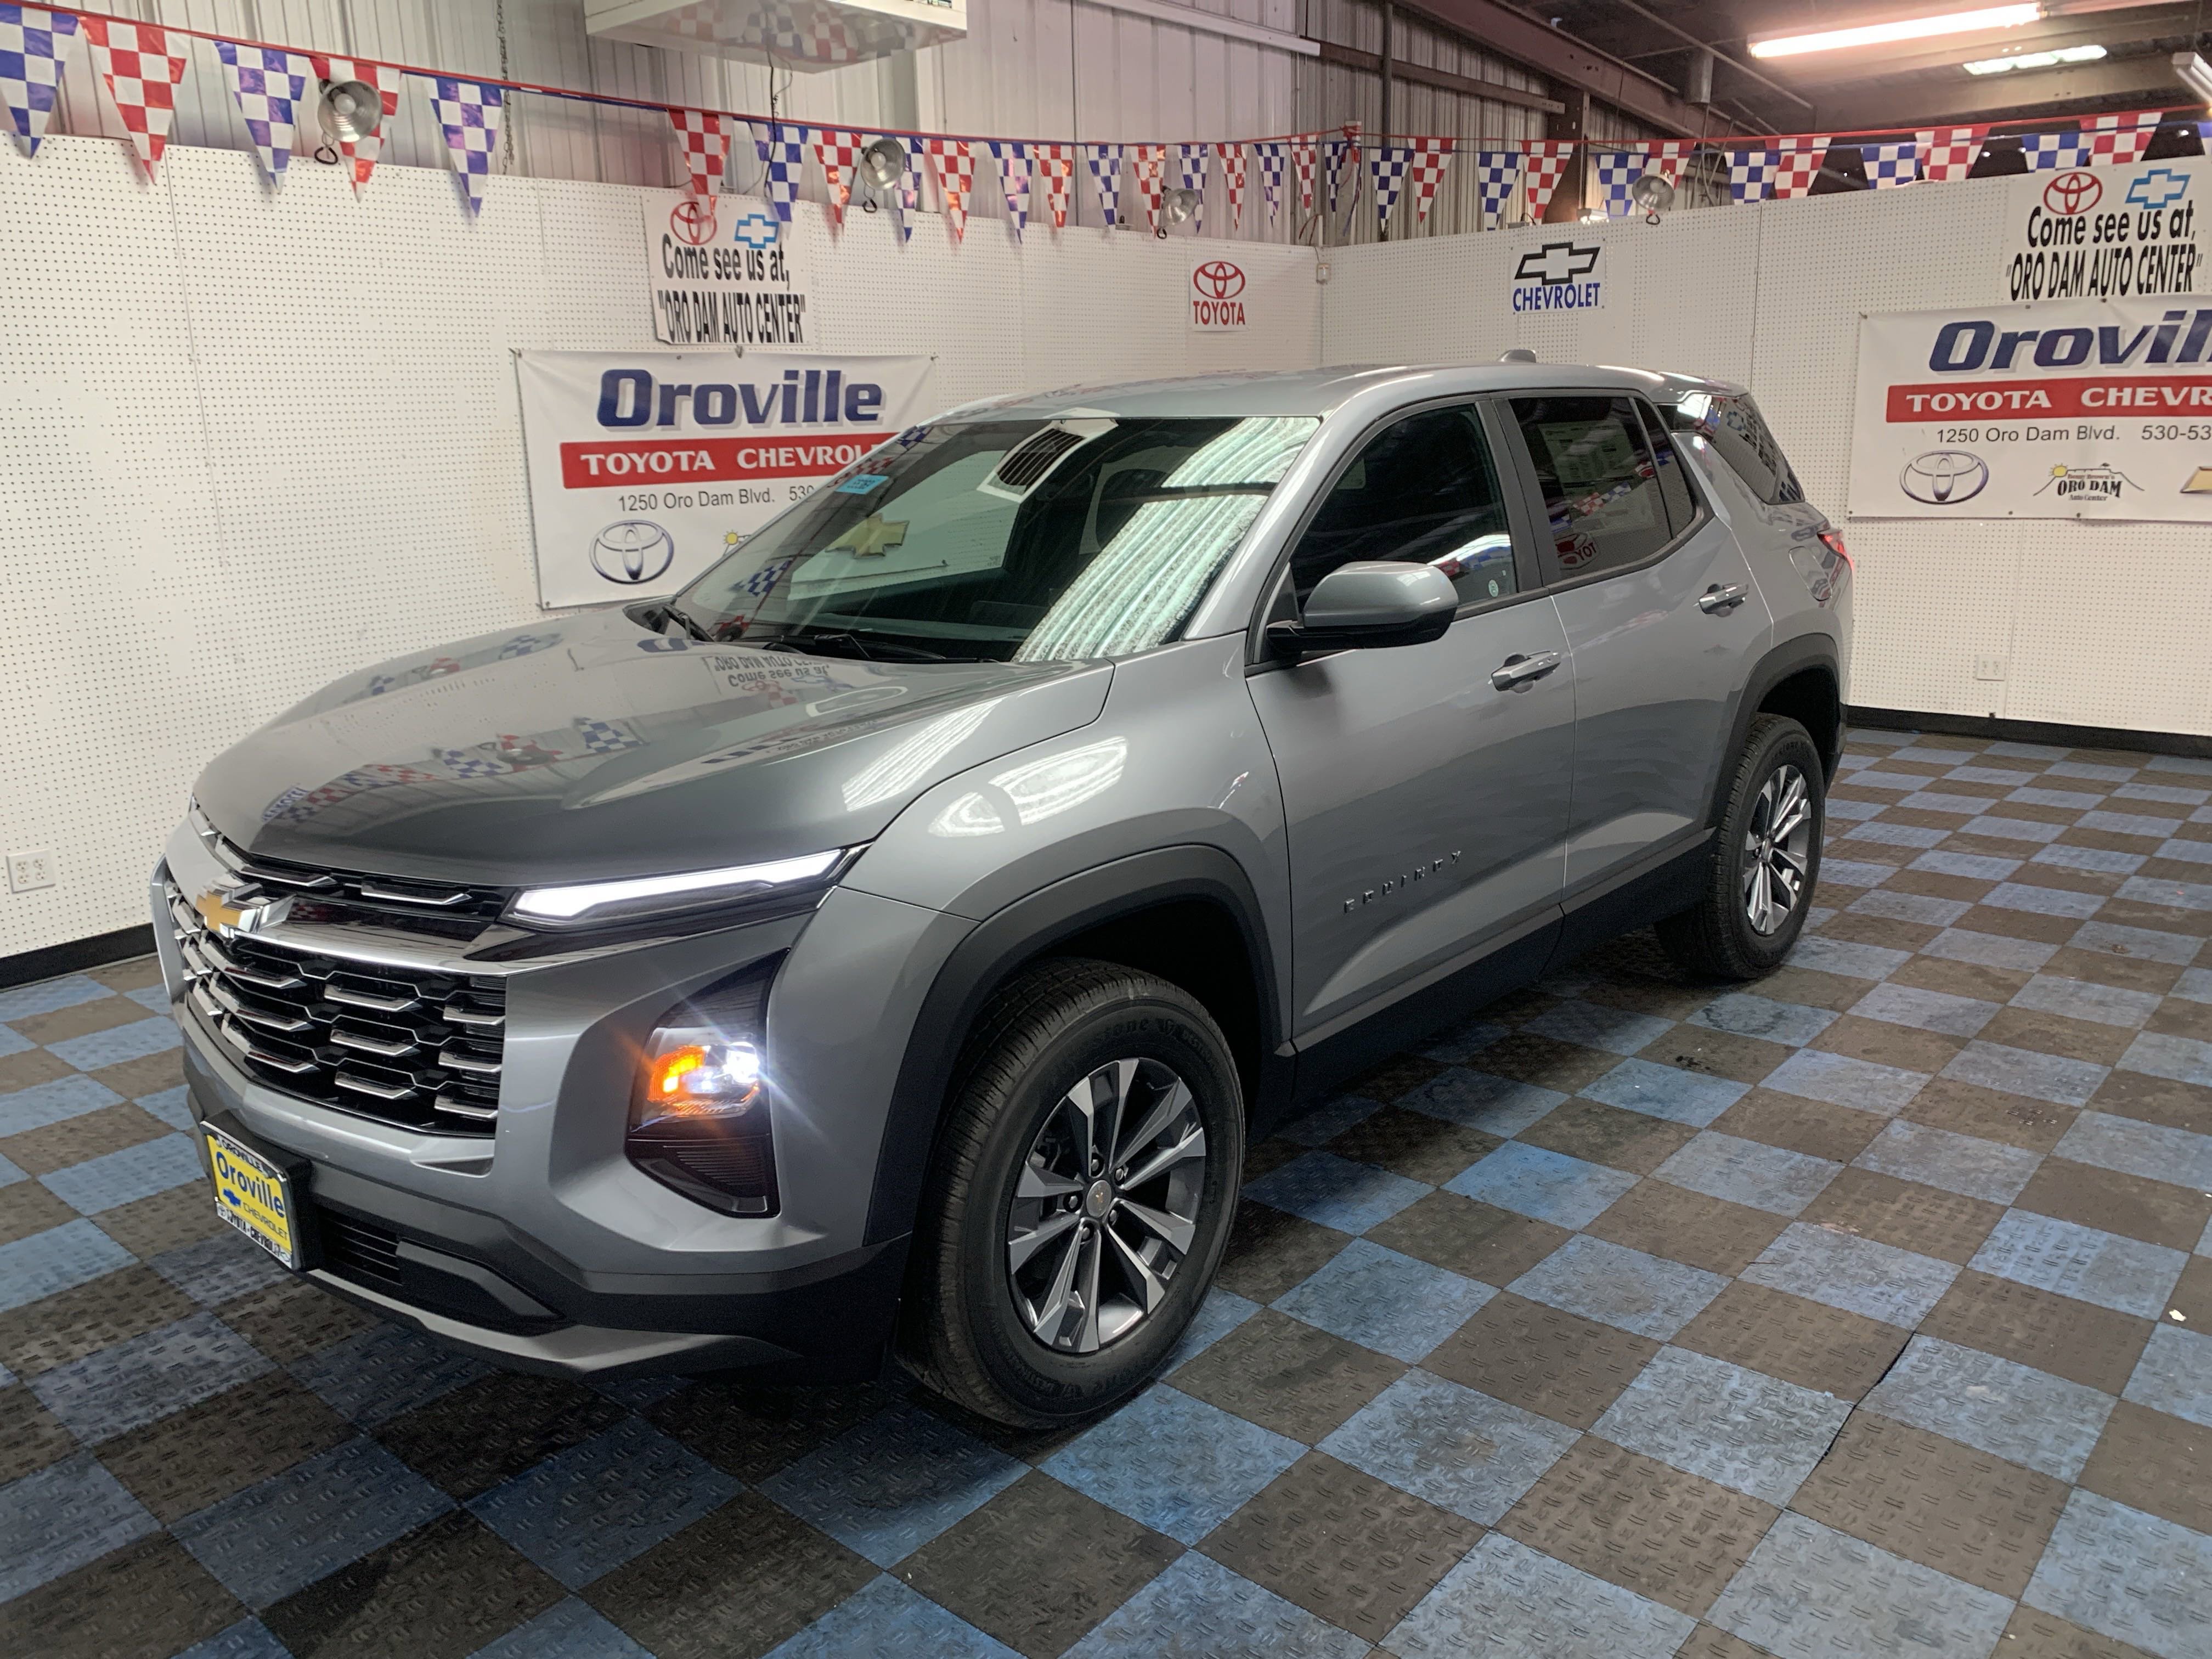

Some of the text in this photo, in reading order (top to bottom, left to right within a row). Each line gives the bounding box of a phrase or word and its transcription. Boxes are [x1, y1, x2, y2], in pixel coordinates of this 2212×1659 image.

[2028, 200, 2196, 247] Come see us at,
[662, 233, 790, 291] Come see us at,
[2006, 243, 2203, 301] "ORO DAM AUTO CENTER"
[657, 290, 806, 343] "ORO DAM AUTO CENTER"
[1193, 300, 1246, 326] TOYOTA
[1513, 283, 1601, 312] CHEVROLET
[1929, 309, 2212, 372] Orovil
[596, 369, 882, 429] Oroville
[1906, 389, 2053, 413] TOYOTA
[1937, 428, 1979, 443] 1250
[1986, 427, 2019, 442] Oro
[2026, 426, 2069, 441] Dam
[2076, 425, 2120, 441] Blvd.
[580, 443, 880, 476] TOYOTA CHEVROL
[619, 493, 658, 512] 1250
[663, 491, 693, 509] Oro
[699, 490, 734, 507] Dam
[739, 488, 775, 504] Blvd.
[2058, 479, 2122, 498] ORO DAM
[216, 1151, 285, 1218] Oroville
[242, 1201, 289, 1241] CHEVROLET
